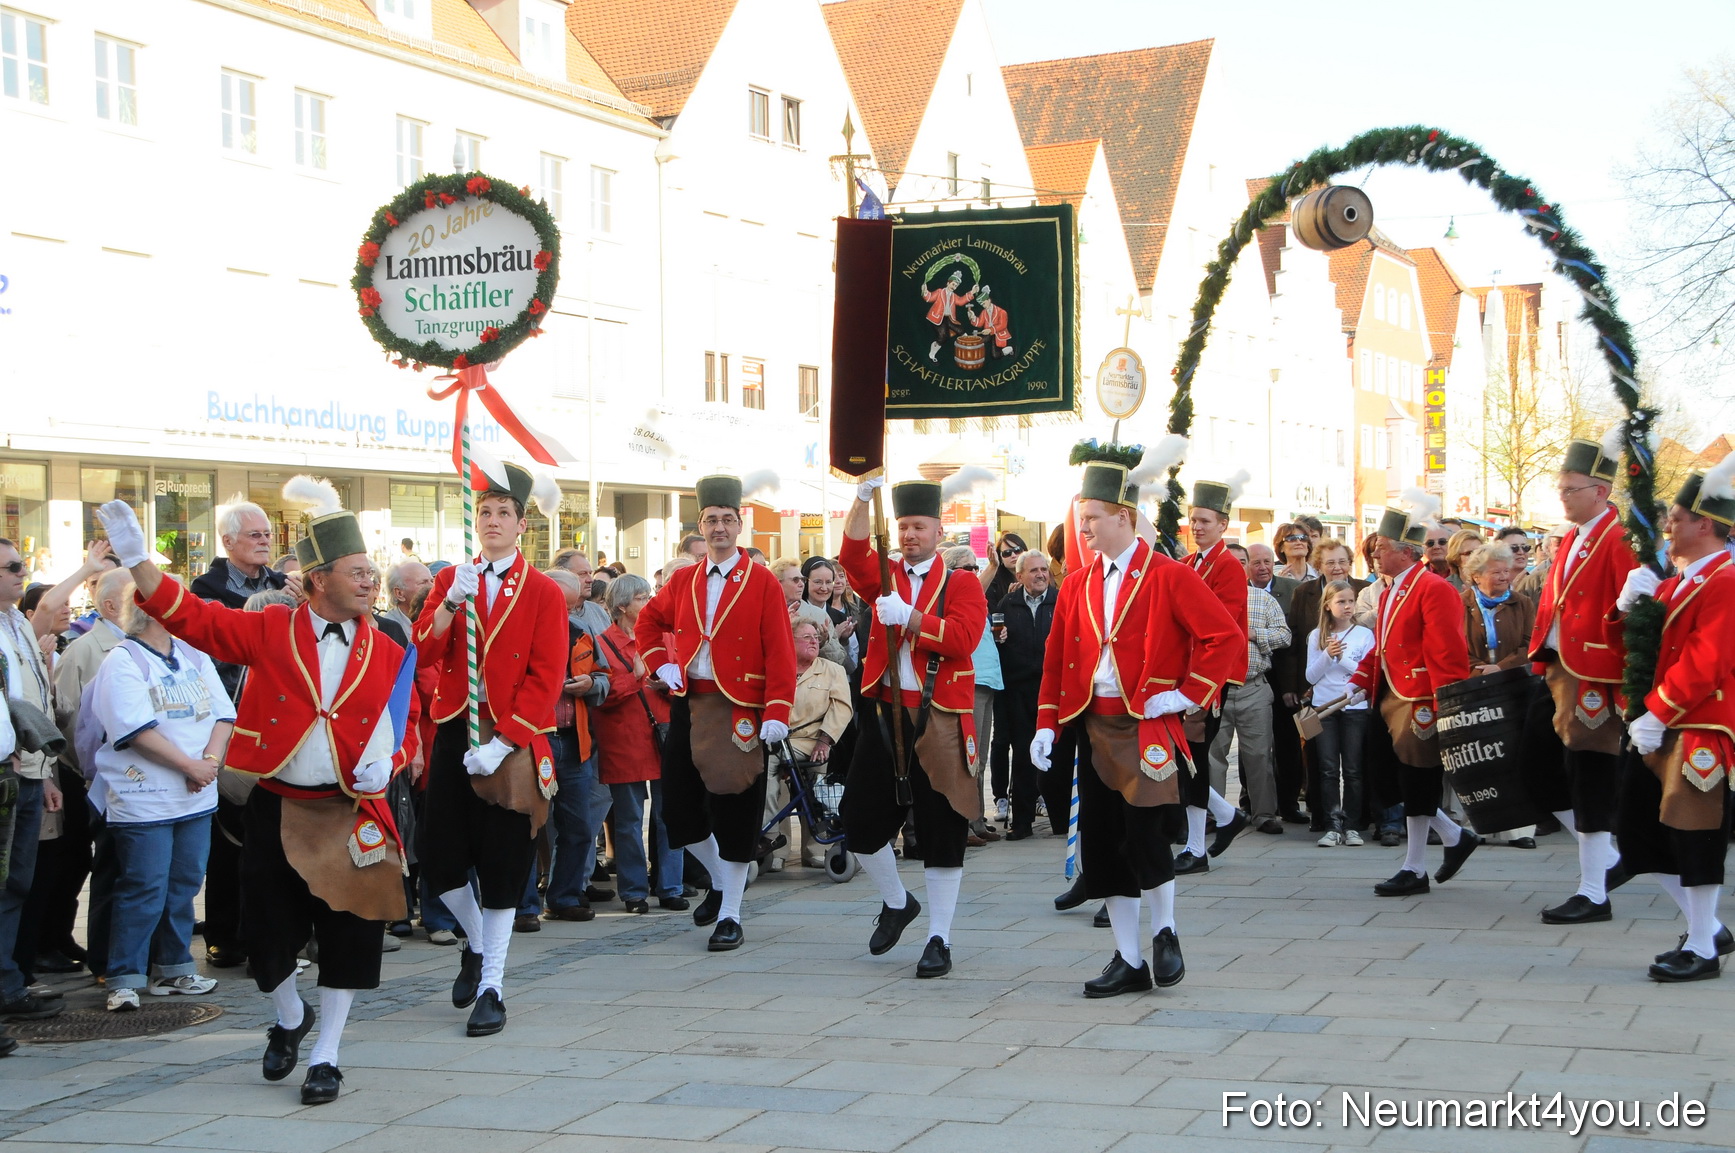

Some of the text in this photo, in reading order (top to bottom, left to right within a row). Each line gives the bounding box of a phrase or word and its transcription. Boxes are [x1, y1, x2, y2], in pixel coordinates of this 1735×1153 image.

[408, 201, 495, 257] 20 Jahre
[385, 244, 533, 281] Lammsbräu
[902, 234, 1028, 280] Neumarkter Lammsbräu
[404, 281, 514, 313] Schäffler
[891, 388, 911, 399] gegr.
[1026, 380, 1048, 391] 1990
[1102, 376, 1139, 390] Lammsbräu
[207, 390, 501, 446] Buchhandlung Ruppcht
[1427, 369, 1446, 470] HOTEL
[167, 480, 212, 497] Rupprecht
[1473, 786, 1499, 803] 1990
